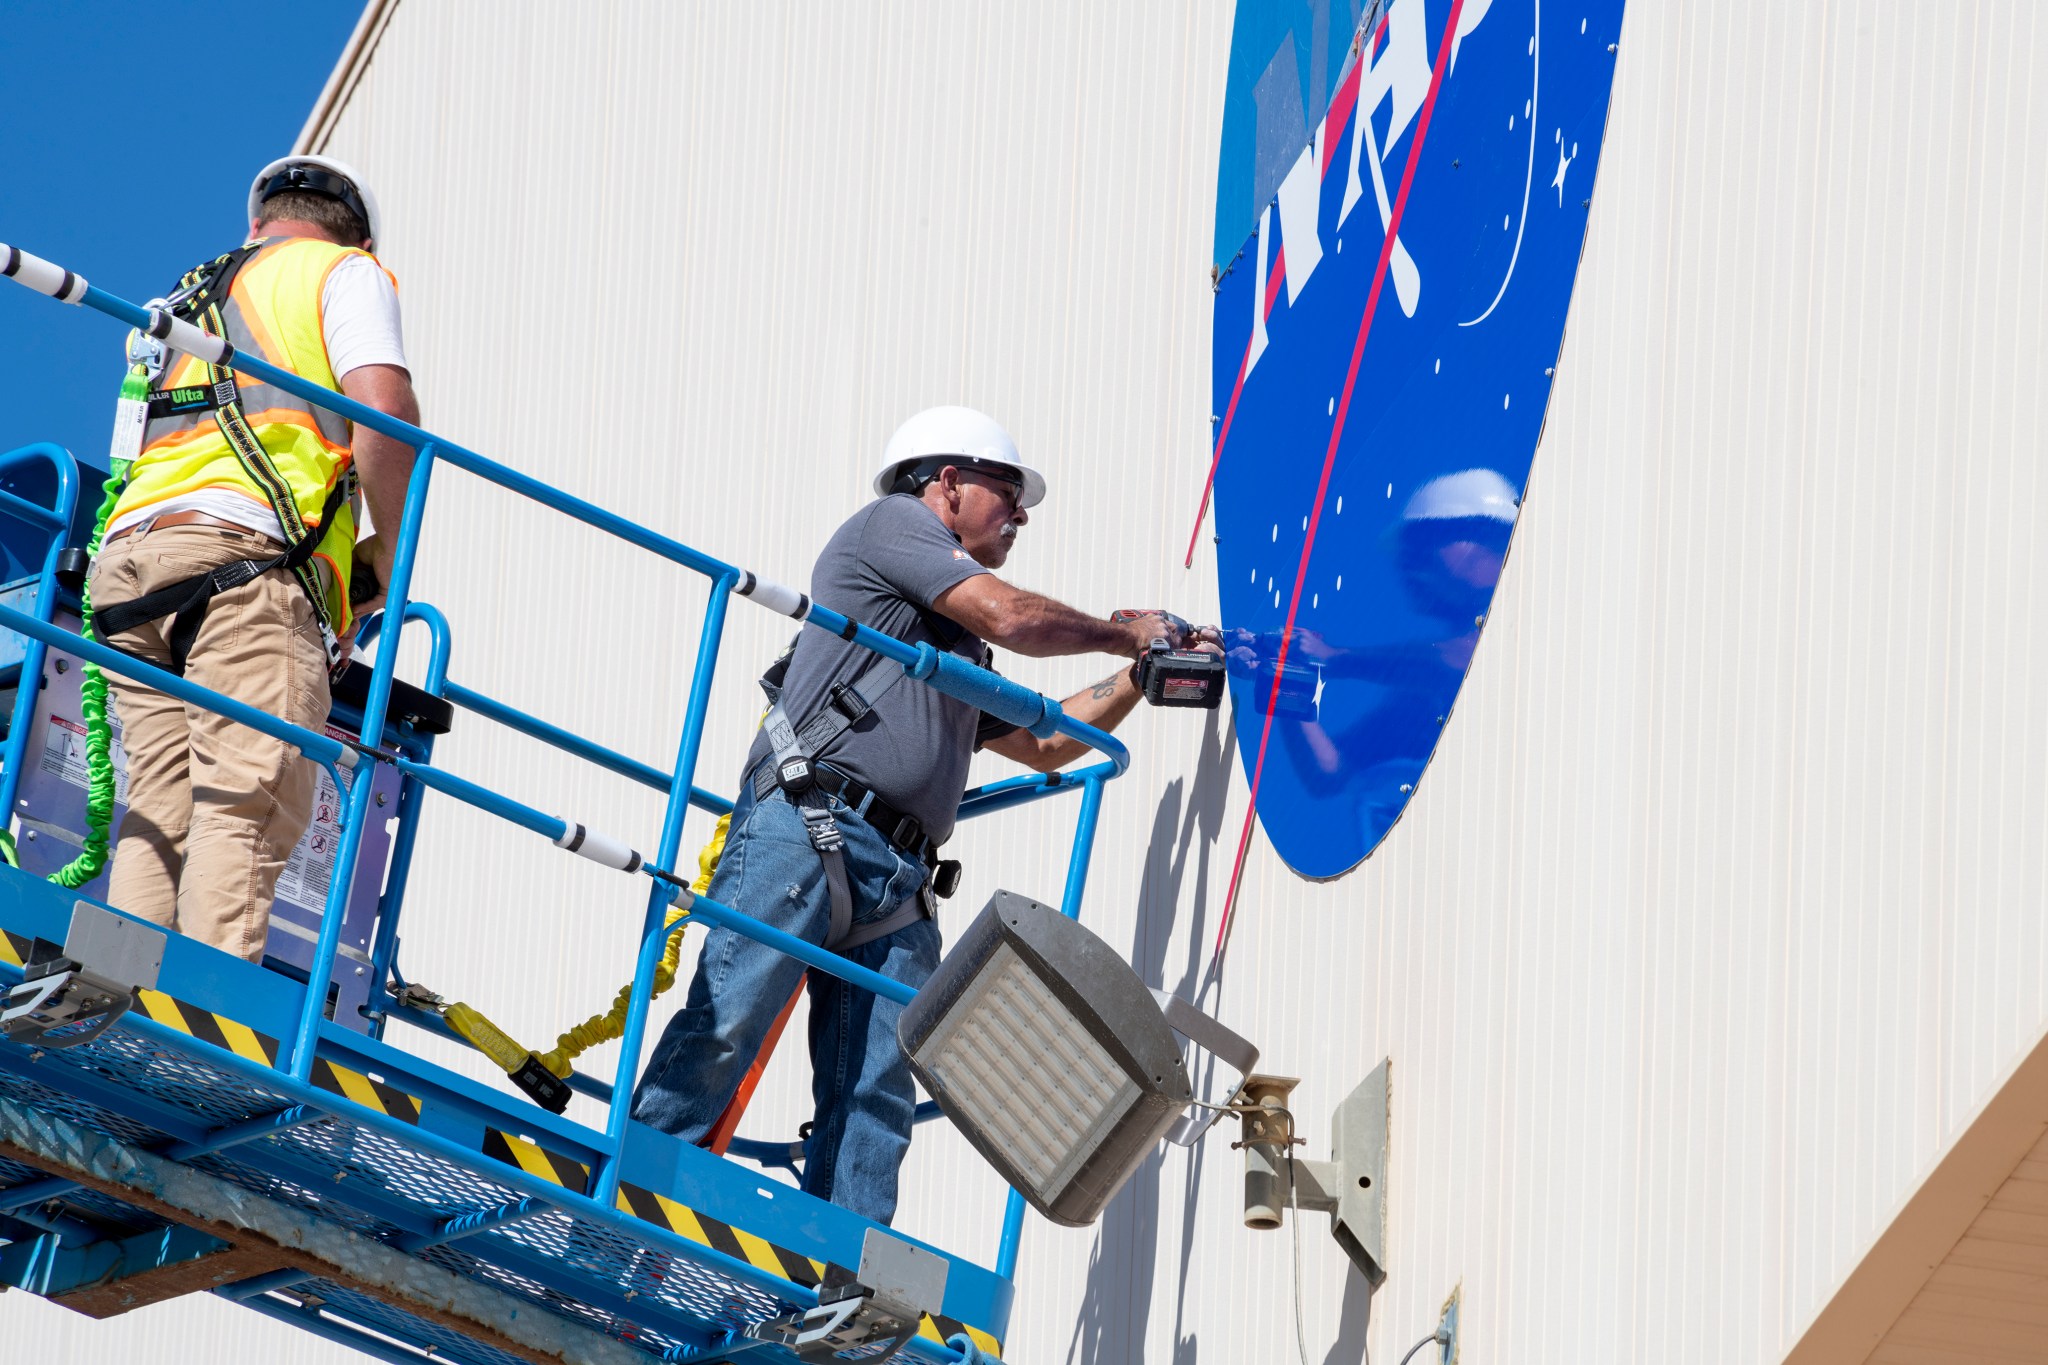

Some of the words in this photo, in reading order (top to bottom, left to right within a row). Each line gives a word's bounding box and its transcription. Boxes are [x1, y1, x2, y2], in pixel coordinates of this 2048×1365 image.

[171, 389, 205, 404] Ultra
[785, 764, 806, 779] SALA
[539, 1083, 554, 1099] 3M
